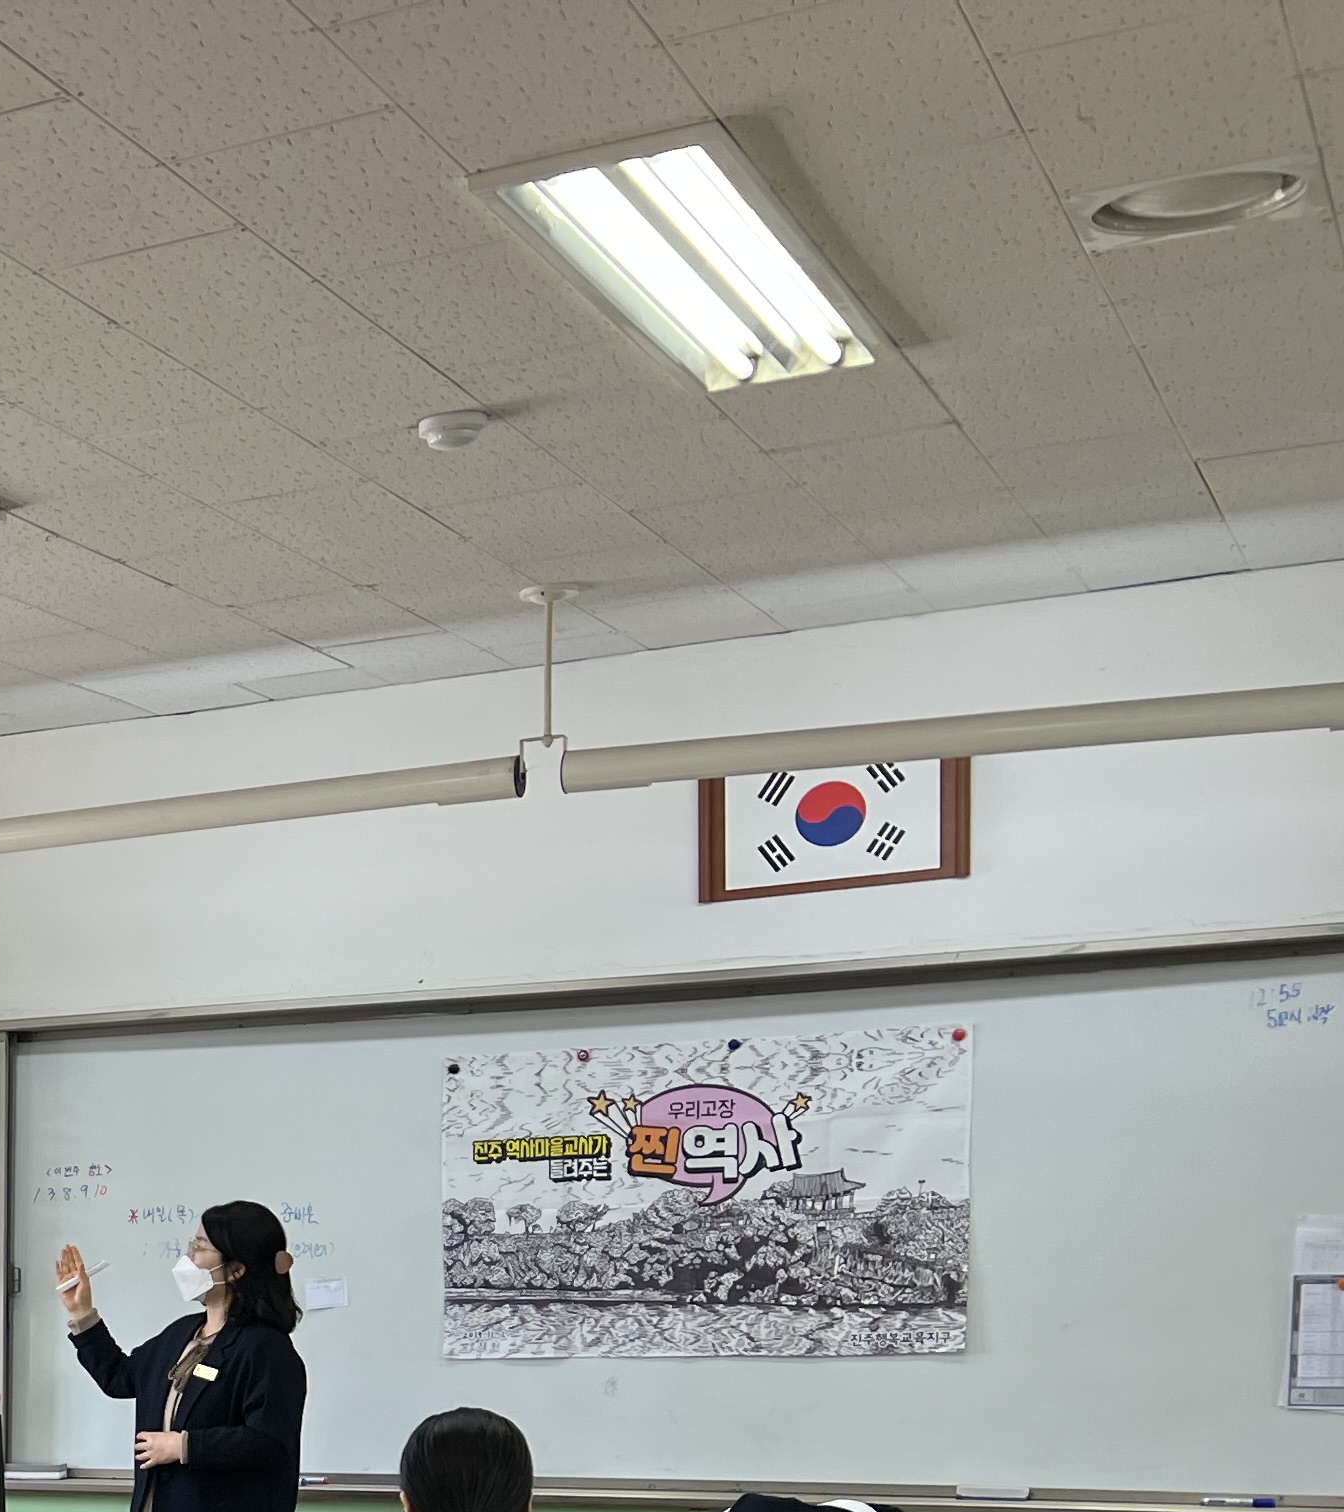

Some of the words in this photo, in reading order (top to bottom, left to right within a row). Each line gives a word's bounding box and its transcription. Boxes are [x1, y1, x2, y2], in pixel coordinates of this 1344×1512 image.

[668, 1099, 736, 1120] 우리고장
[474, 1140, 503, 1162] 진주
[550, 1158, 611, 1180] 들려주는
[851, 1331, 952, 1348] 진주행복교육지구
